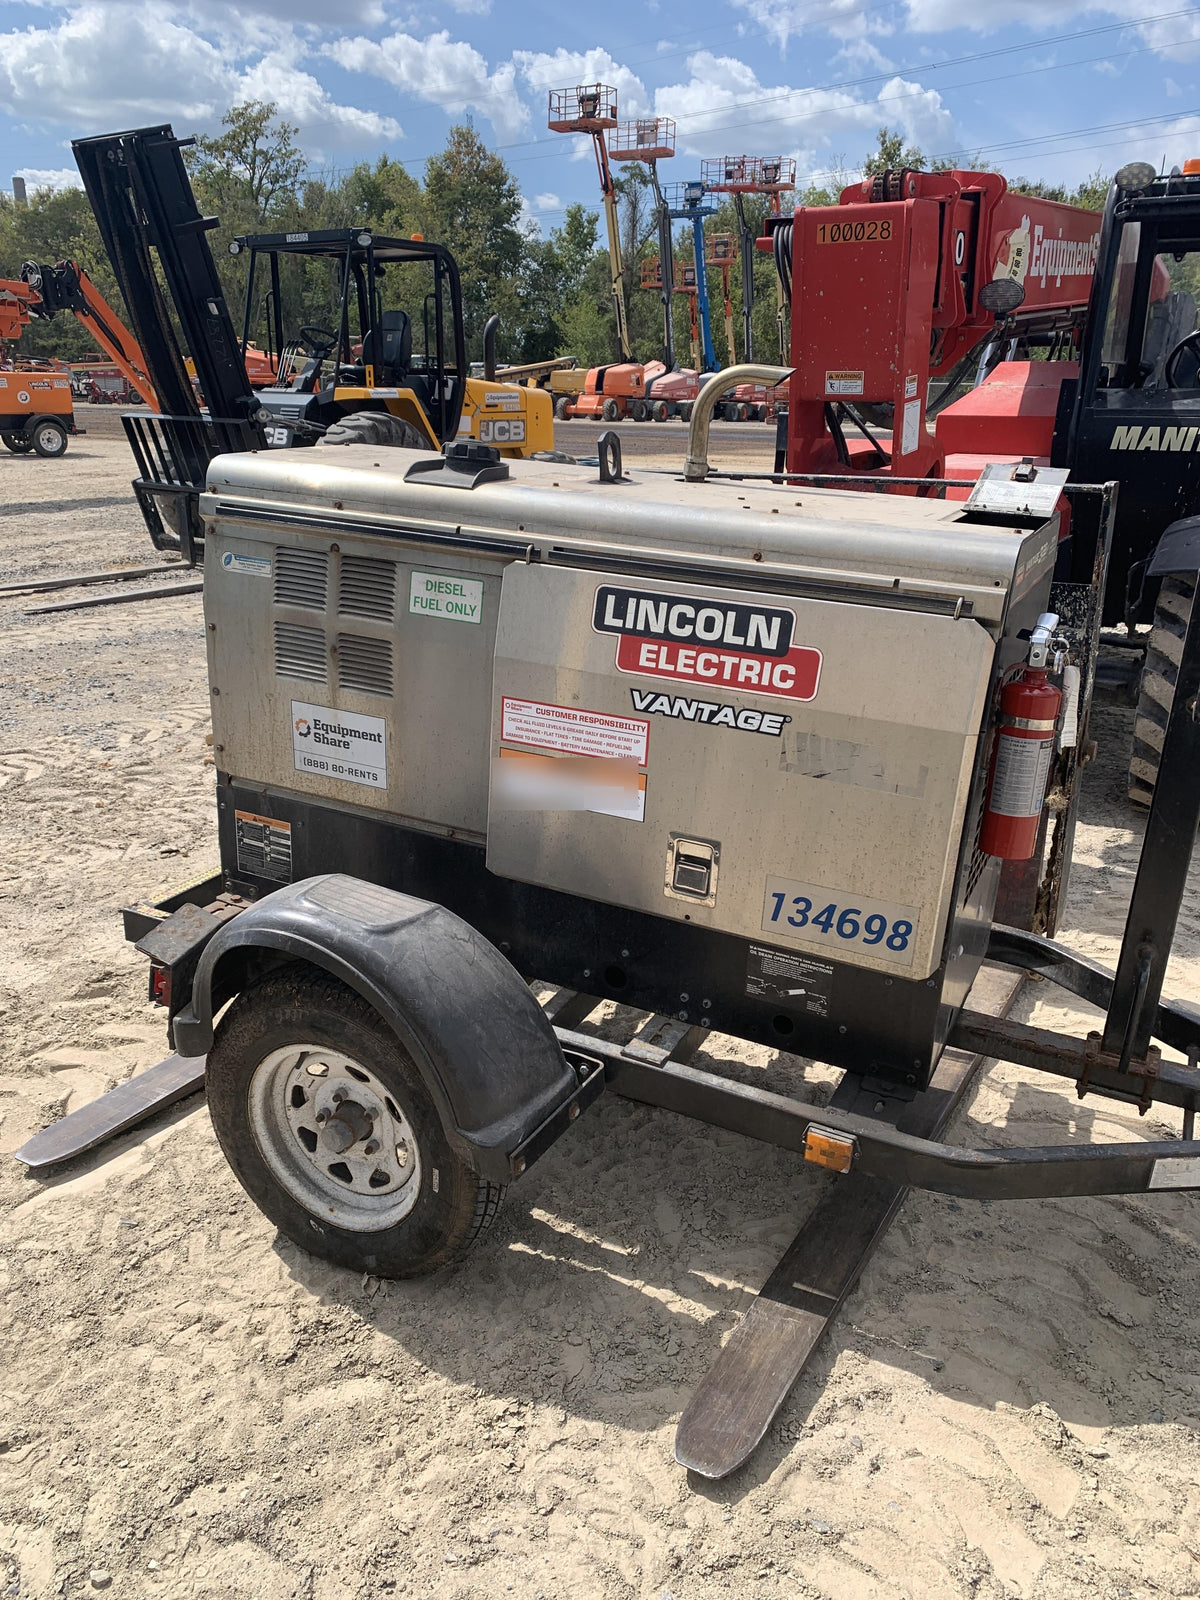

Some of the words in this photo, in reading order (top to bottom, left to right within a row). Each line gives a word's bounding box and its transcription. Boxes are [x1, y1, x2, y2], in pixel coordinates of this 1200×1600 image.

[818, 220, 891, 242] 100028
[264, 428, 288, 444] CB
[480, 421, 525, 442] JCB
[1110, 426, 1200, 452] MANI
[426, 580, 466, 597] DIESEL
[414, 596, 442, 612] FUEL
[446, 601, 477, 616] ONLY
[604, 594, 782, 650] LINCOLN
[638, 642, 796, 689] ELECTRIC
[313, 718, 382, 744] Equipment
[536, 708, 578, 720] CUSTOMER
[579, 715, 646, 732] RESPONSIBILITY
[314, 732, 350, 750] Share
[515, 726, 540, 734] INSURANCE
[606, 742, 632, 751] REFUELING
[531, 737, 557, 745] EQUIPMENT
[581, 746, 614, 756] MAINTENANCE
[303, 757, 329, 770] (888)
[332, 764, 378, 782] 80-RENTS
[770, 892, 913, 952] 134698
[773, 955, 799, 966] OPERATION
[800, 962, 833, 974] INSTRUCTIONS
